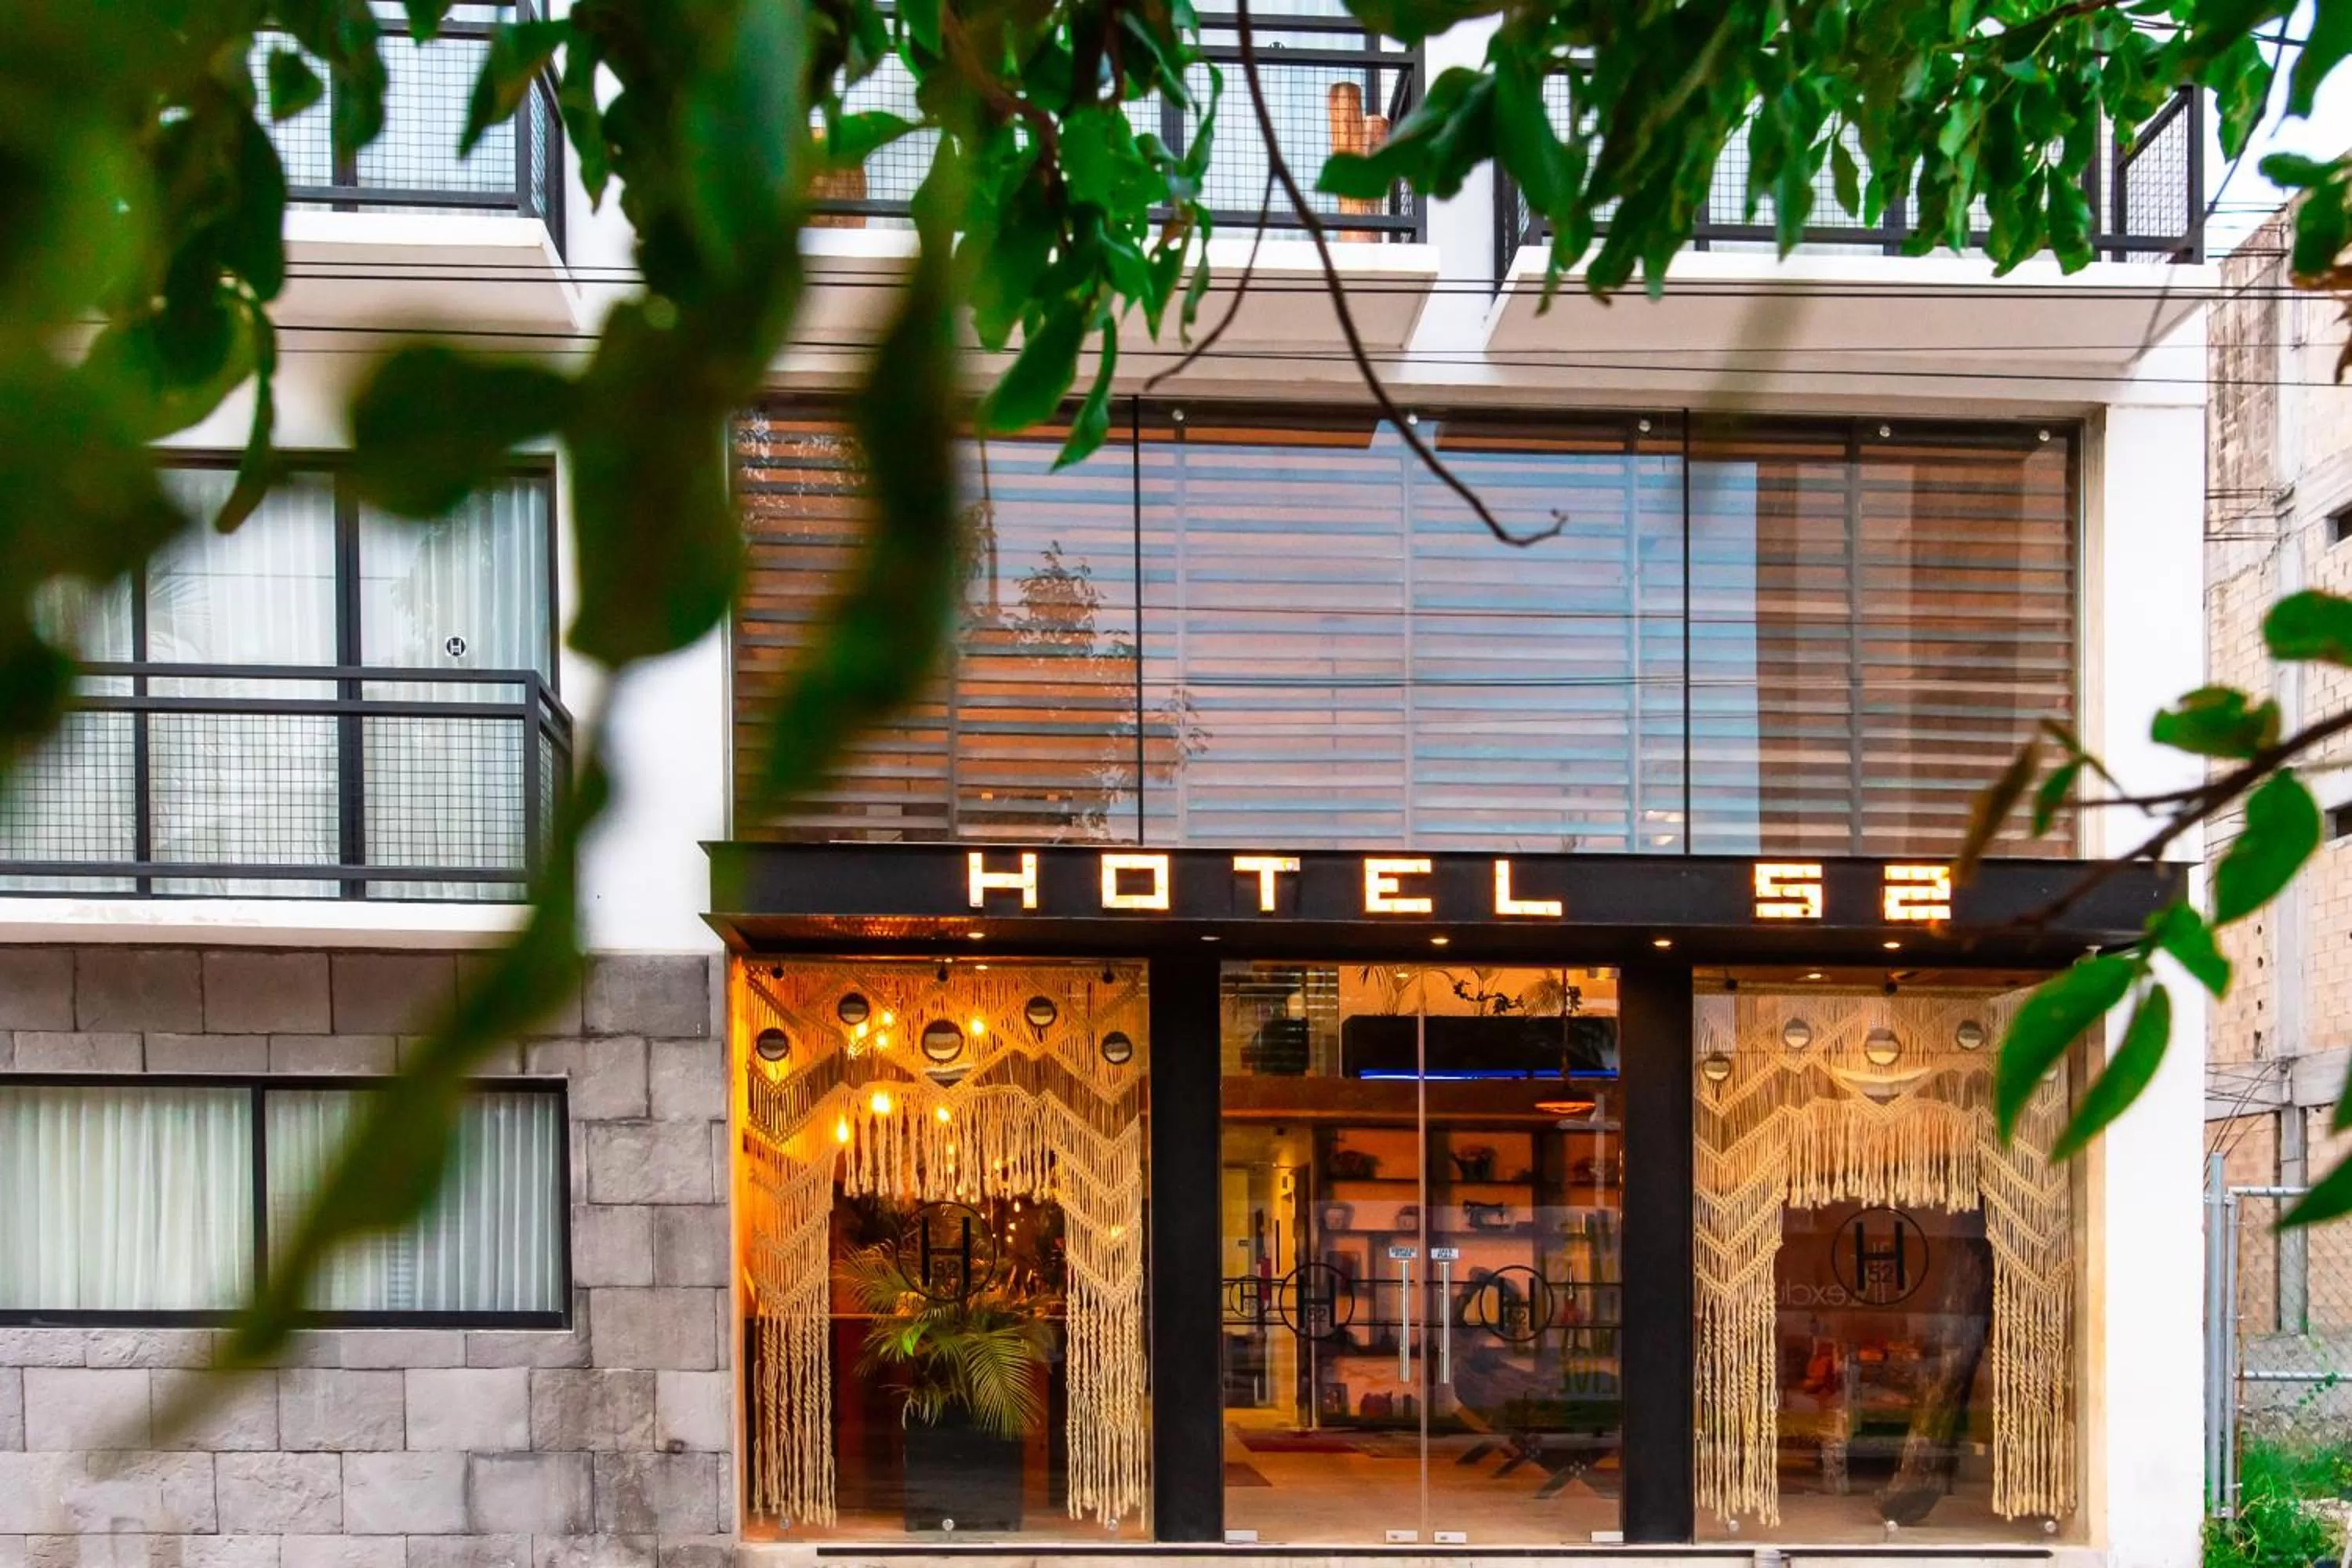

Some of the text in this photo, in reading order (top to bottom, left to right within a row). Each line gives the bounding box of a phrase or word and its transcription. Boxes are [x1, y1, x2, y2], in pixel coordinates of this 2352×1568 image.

[968, 852, 1951, 920] HOTEL 52
[921, 1216, 971, 1288] H
[1856, 1221, 1905, 1290] H
[1298, 1275, 1336, 1329] H
